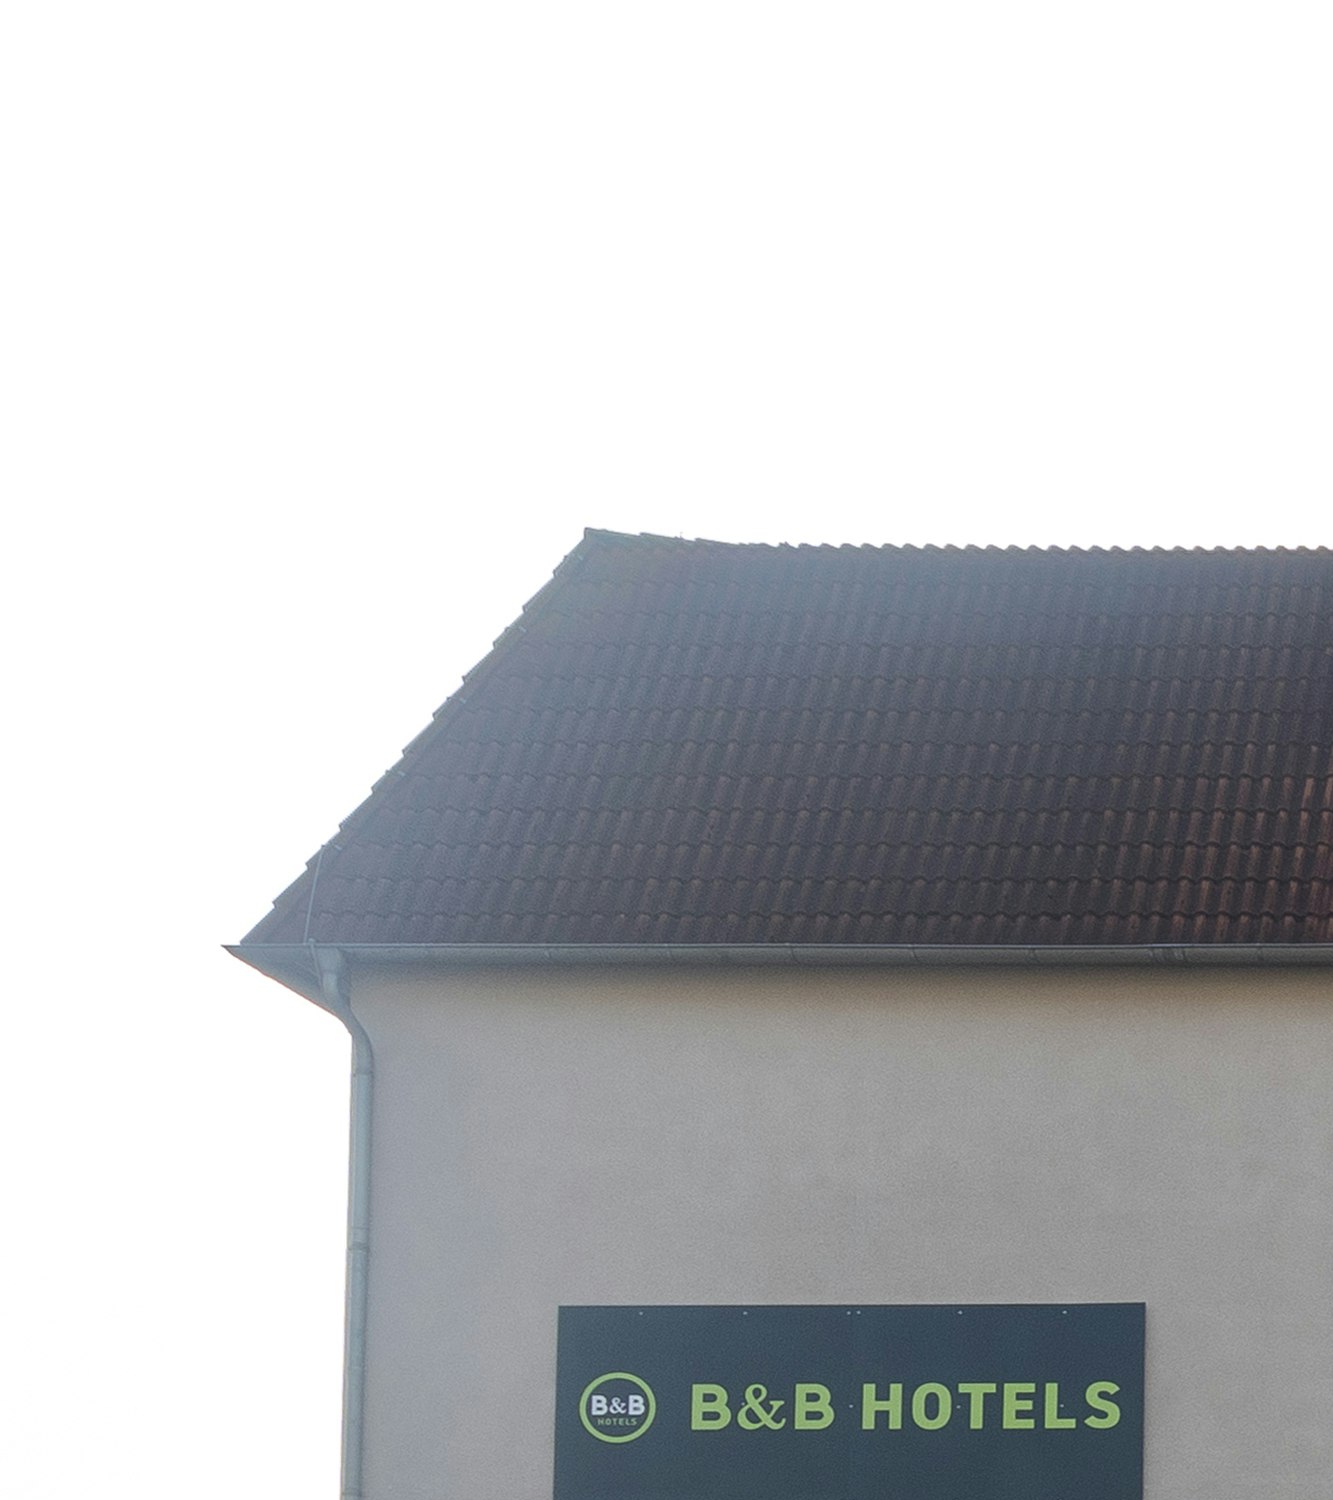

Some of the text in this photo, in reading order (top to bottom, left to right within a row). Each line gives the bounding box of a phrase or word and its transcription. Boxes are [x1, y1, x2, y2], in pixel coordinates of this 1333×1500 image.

[591, 1394, 646, 1416] B&B
[690, 1381, 1122, 1431] B&B HOTELS
[597, 1417, 638, 1426] HOTELS
